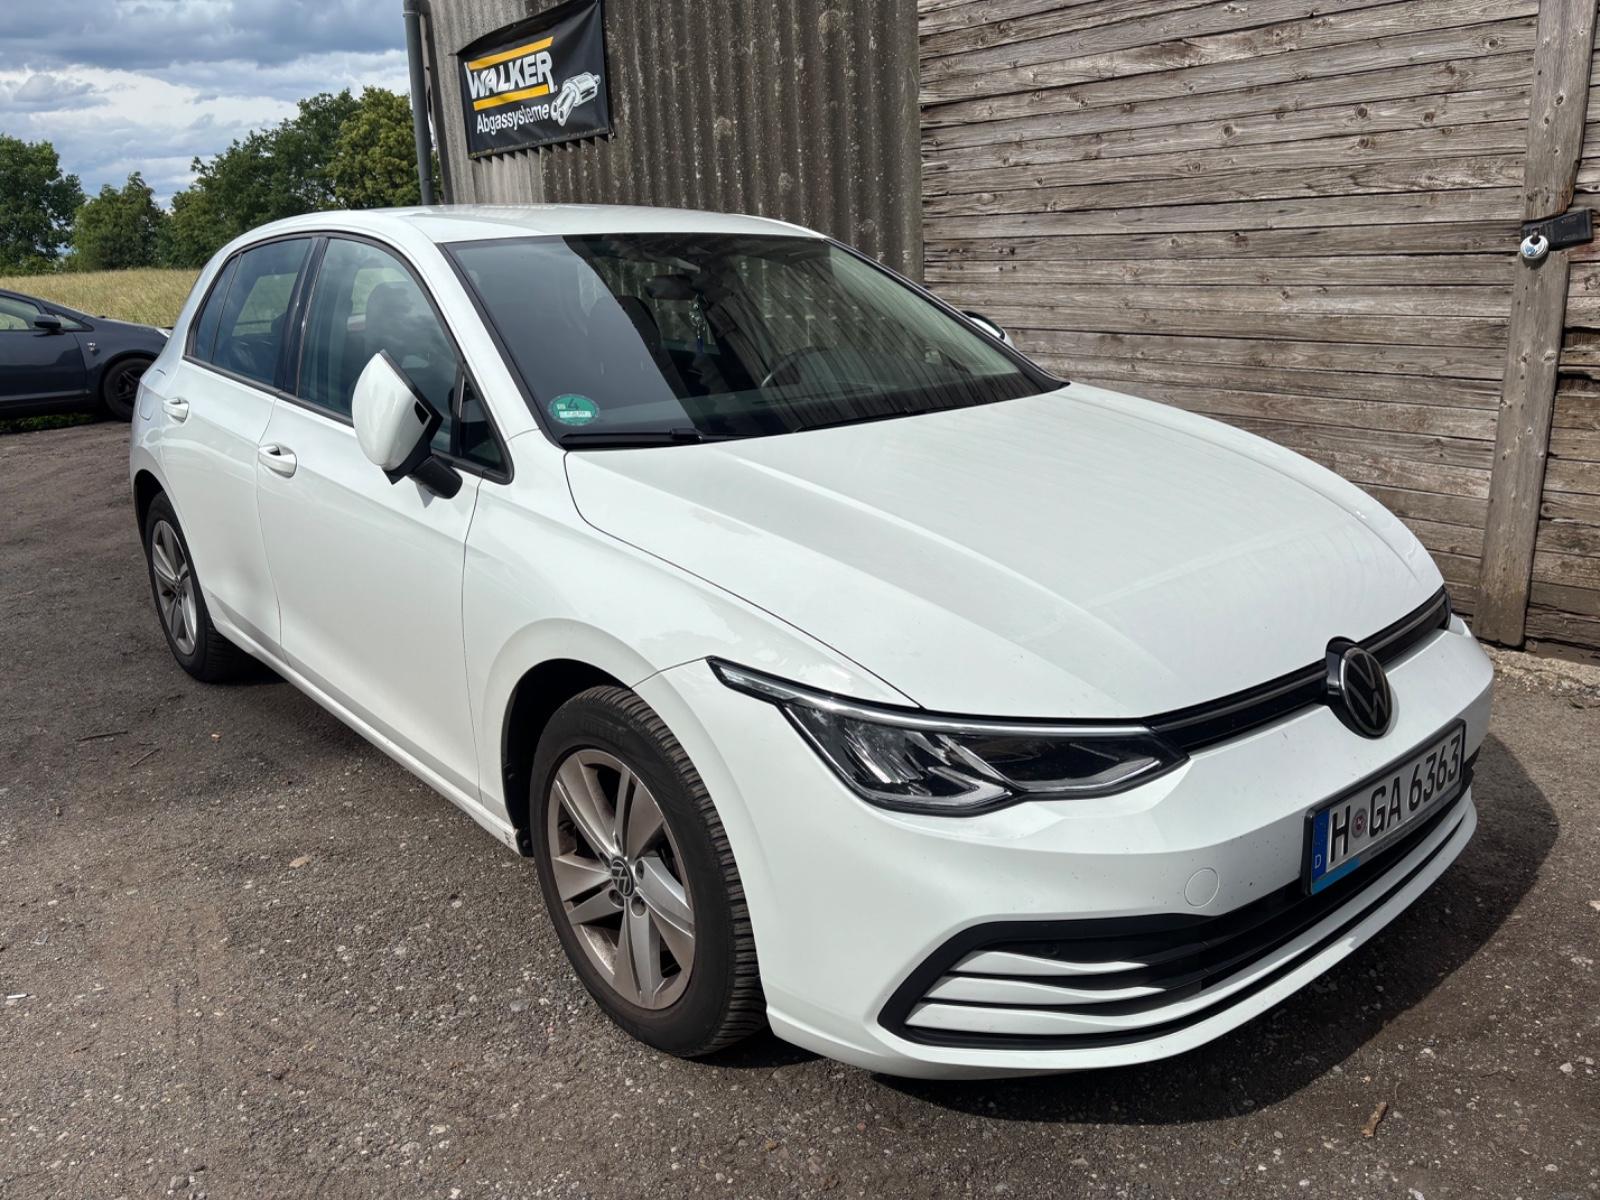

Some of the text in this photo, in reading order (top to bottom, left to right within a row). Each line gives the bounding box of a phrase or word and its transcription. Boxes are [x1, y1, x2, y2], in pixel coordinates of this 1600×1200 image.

[464, 51, 555, 99] WALKER
[476, 104, 549, 135] Abgassysteme
[568, 398, 579, 410] 4
[1330, 805, 1351, 862] H
[1368, 776, 1402, 837] GA
[1408, 734, 1461, 811] 6363
[1314, 854, 1322, 869] D
